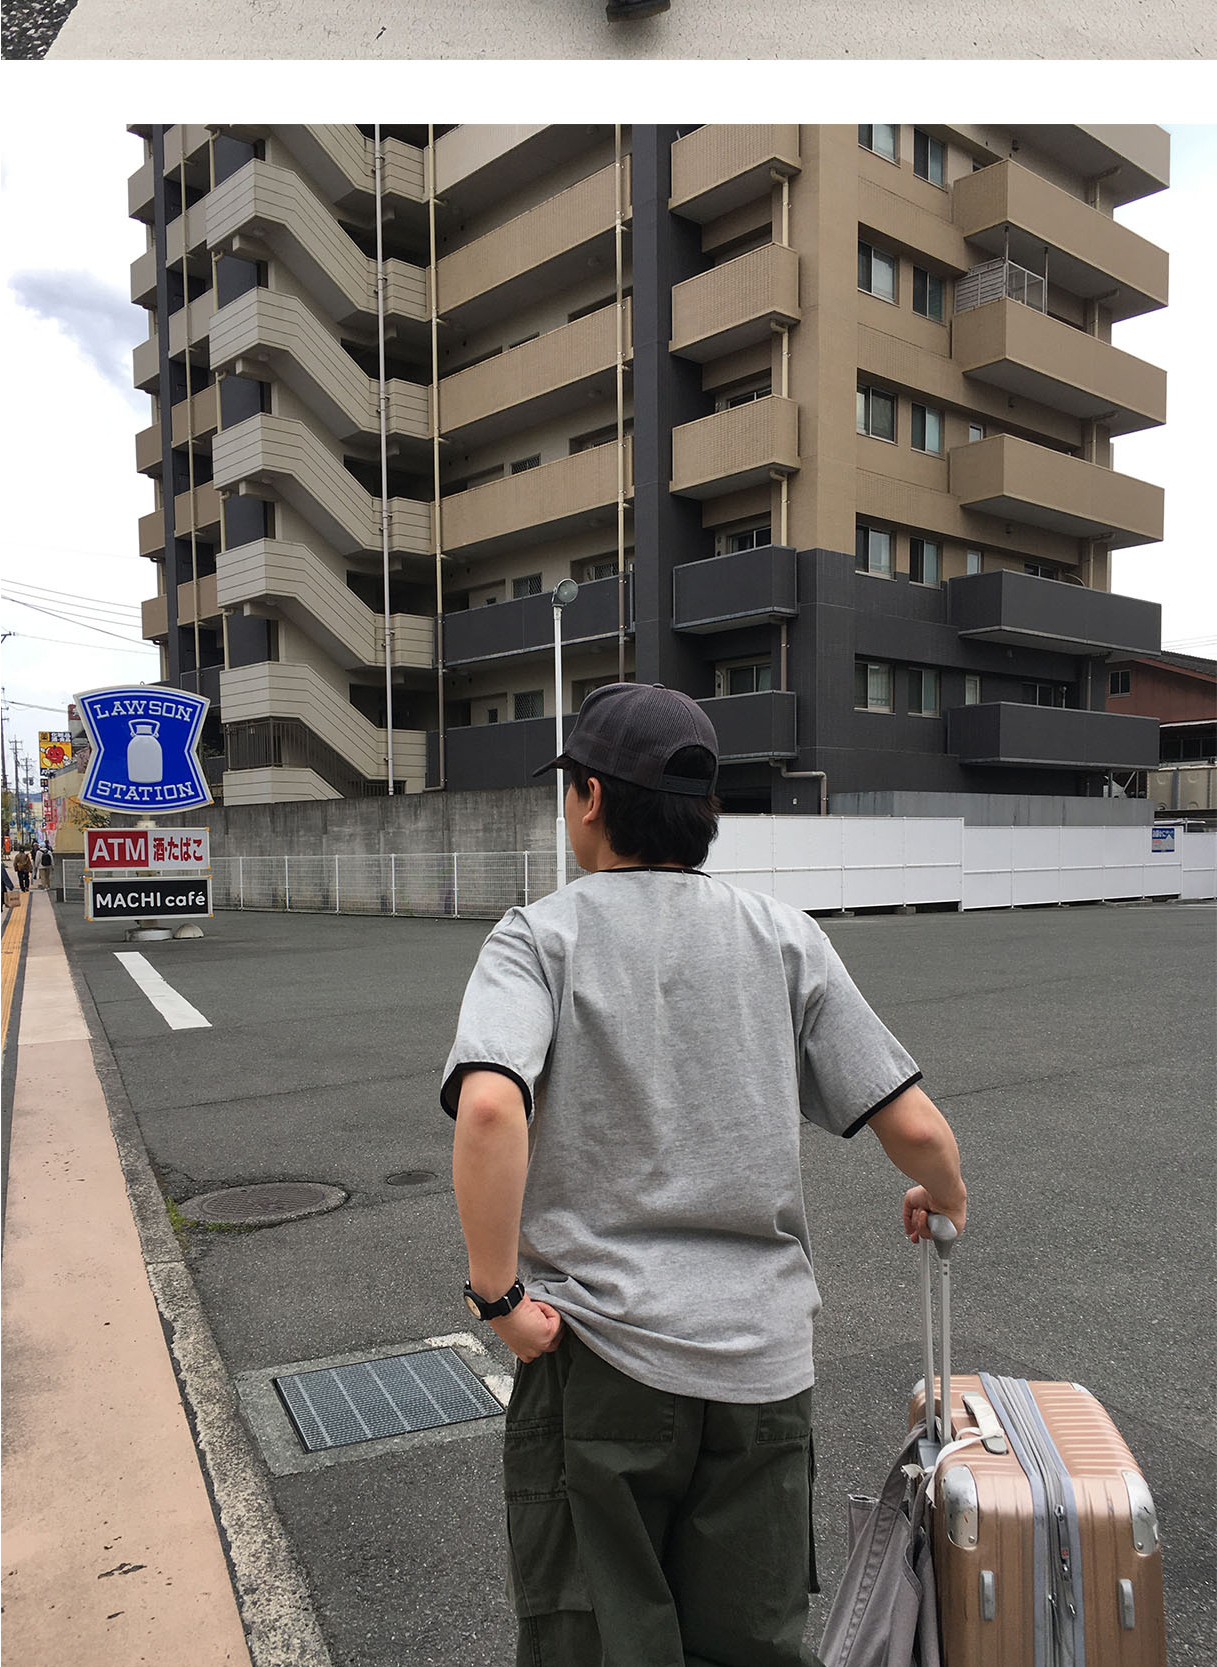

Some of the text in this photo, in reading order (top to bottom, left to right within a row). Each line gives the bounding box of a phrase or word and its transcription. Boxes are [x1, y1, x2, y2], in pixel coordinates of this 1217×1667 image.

[93, 700, 193, 722] LAWSON
[96, 780, 195, 800] STATION
[91, 838, 146, 861] ATM
[153, 836, 203, 862] 酒・たばこ
[96, 891, 206, 908] MACHI café
